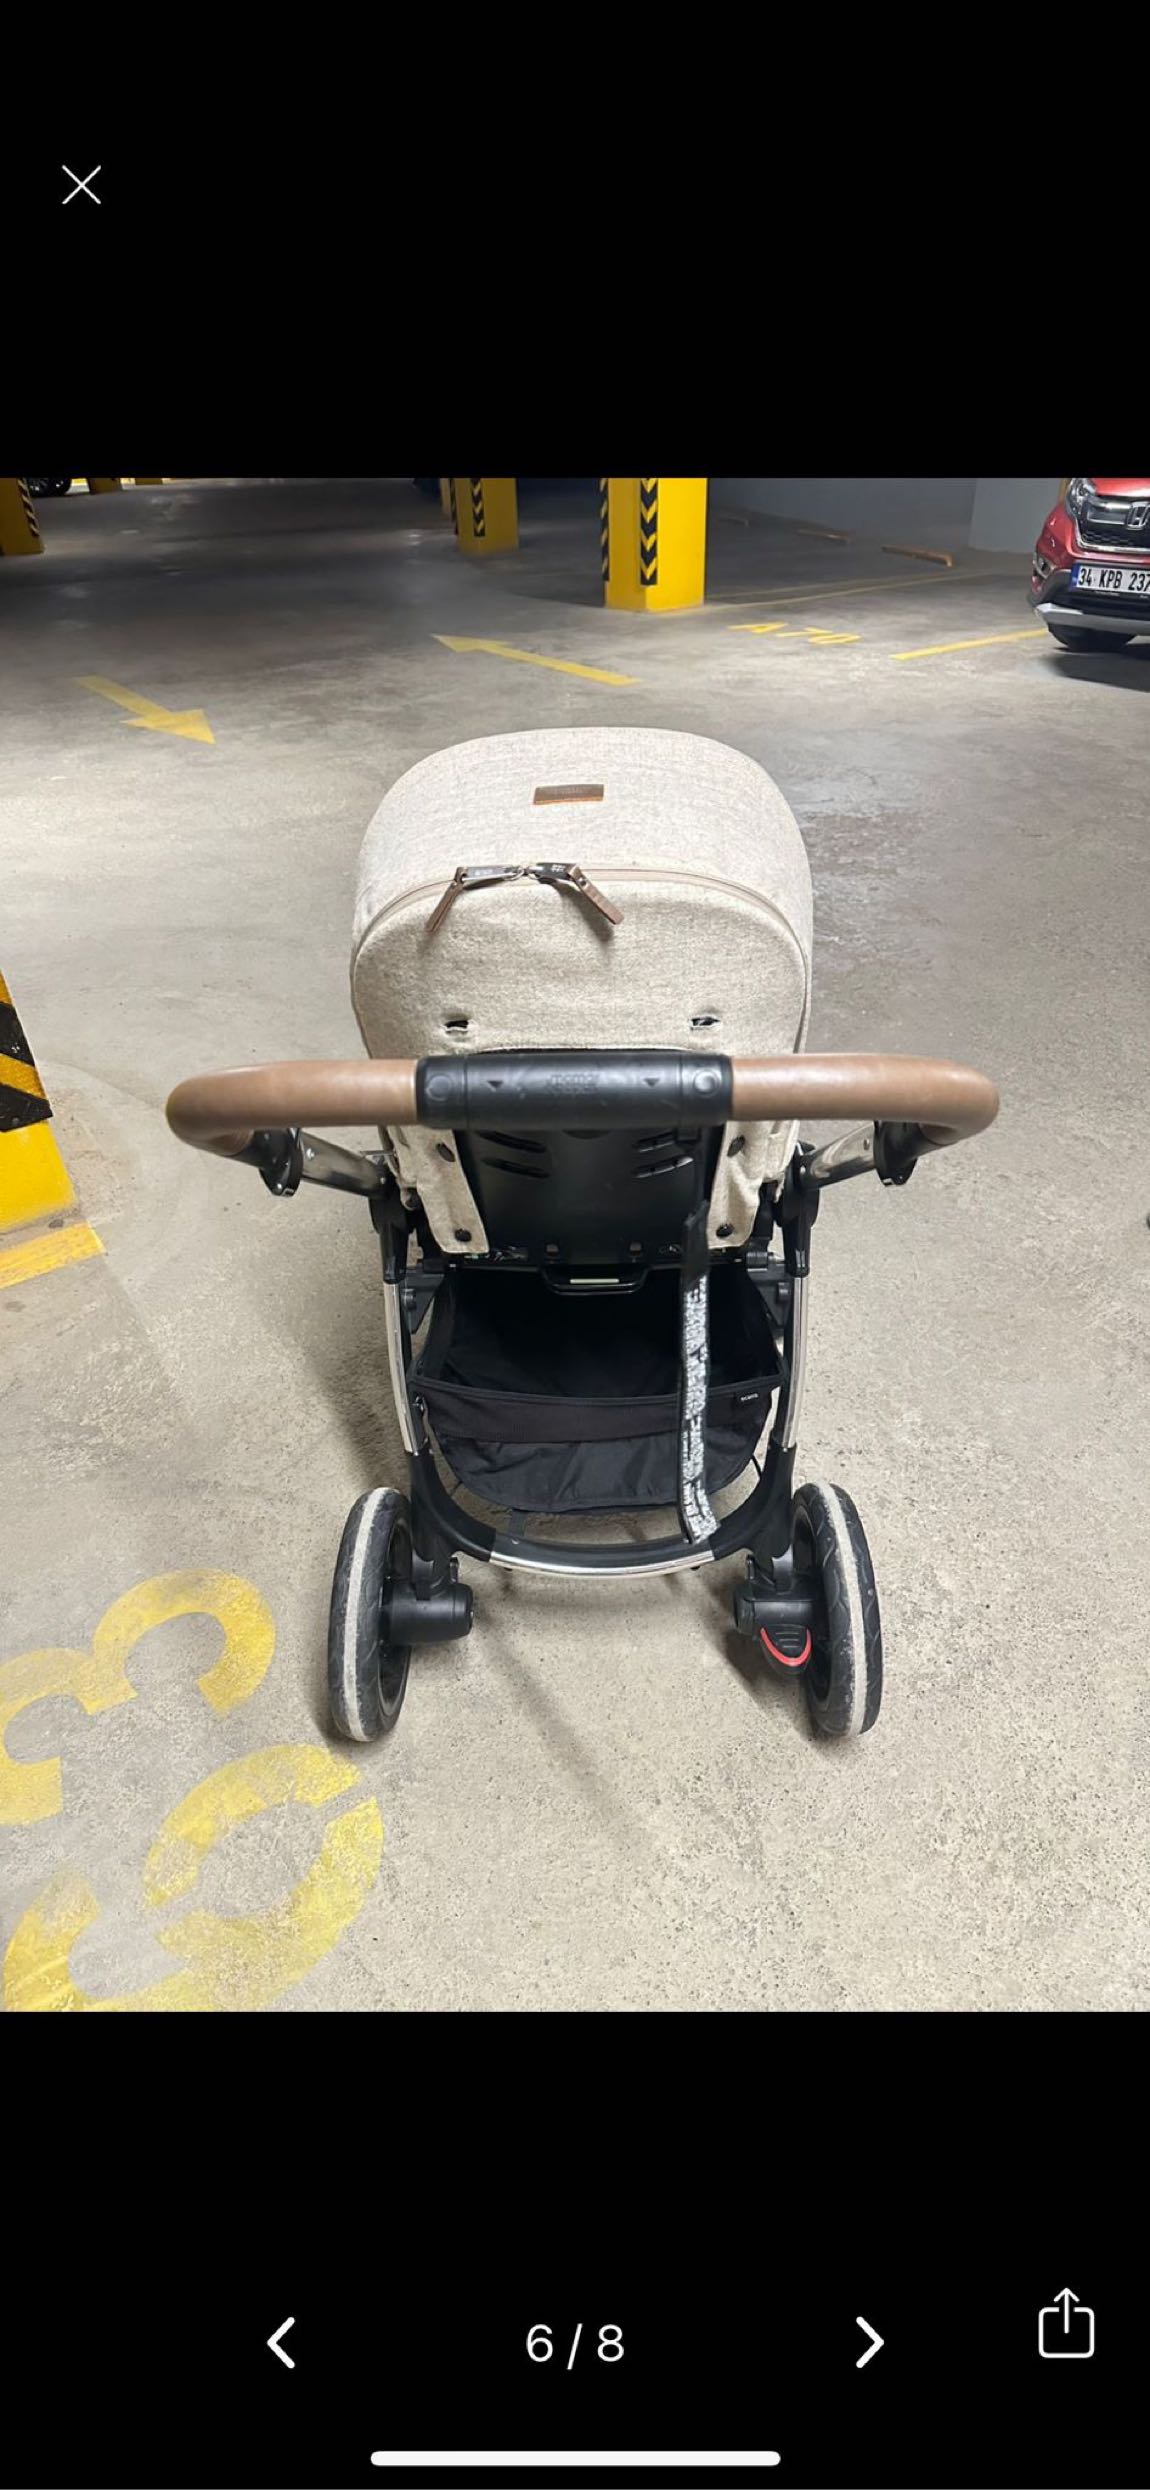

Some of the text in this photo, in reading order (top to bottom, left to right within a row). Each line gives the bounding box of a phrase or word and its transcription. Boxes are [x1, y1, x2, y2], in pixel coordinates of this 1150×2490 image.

[1078, 568, 1150, 592] 34 KPB 237
